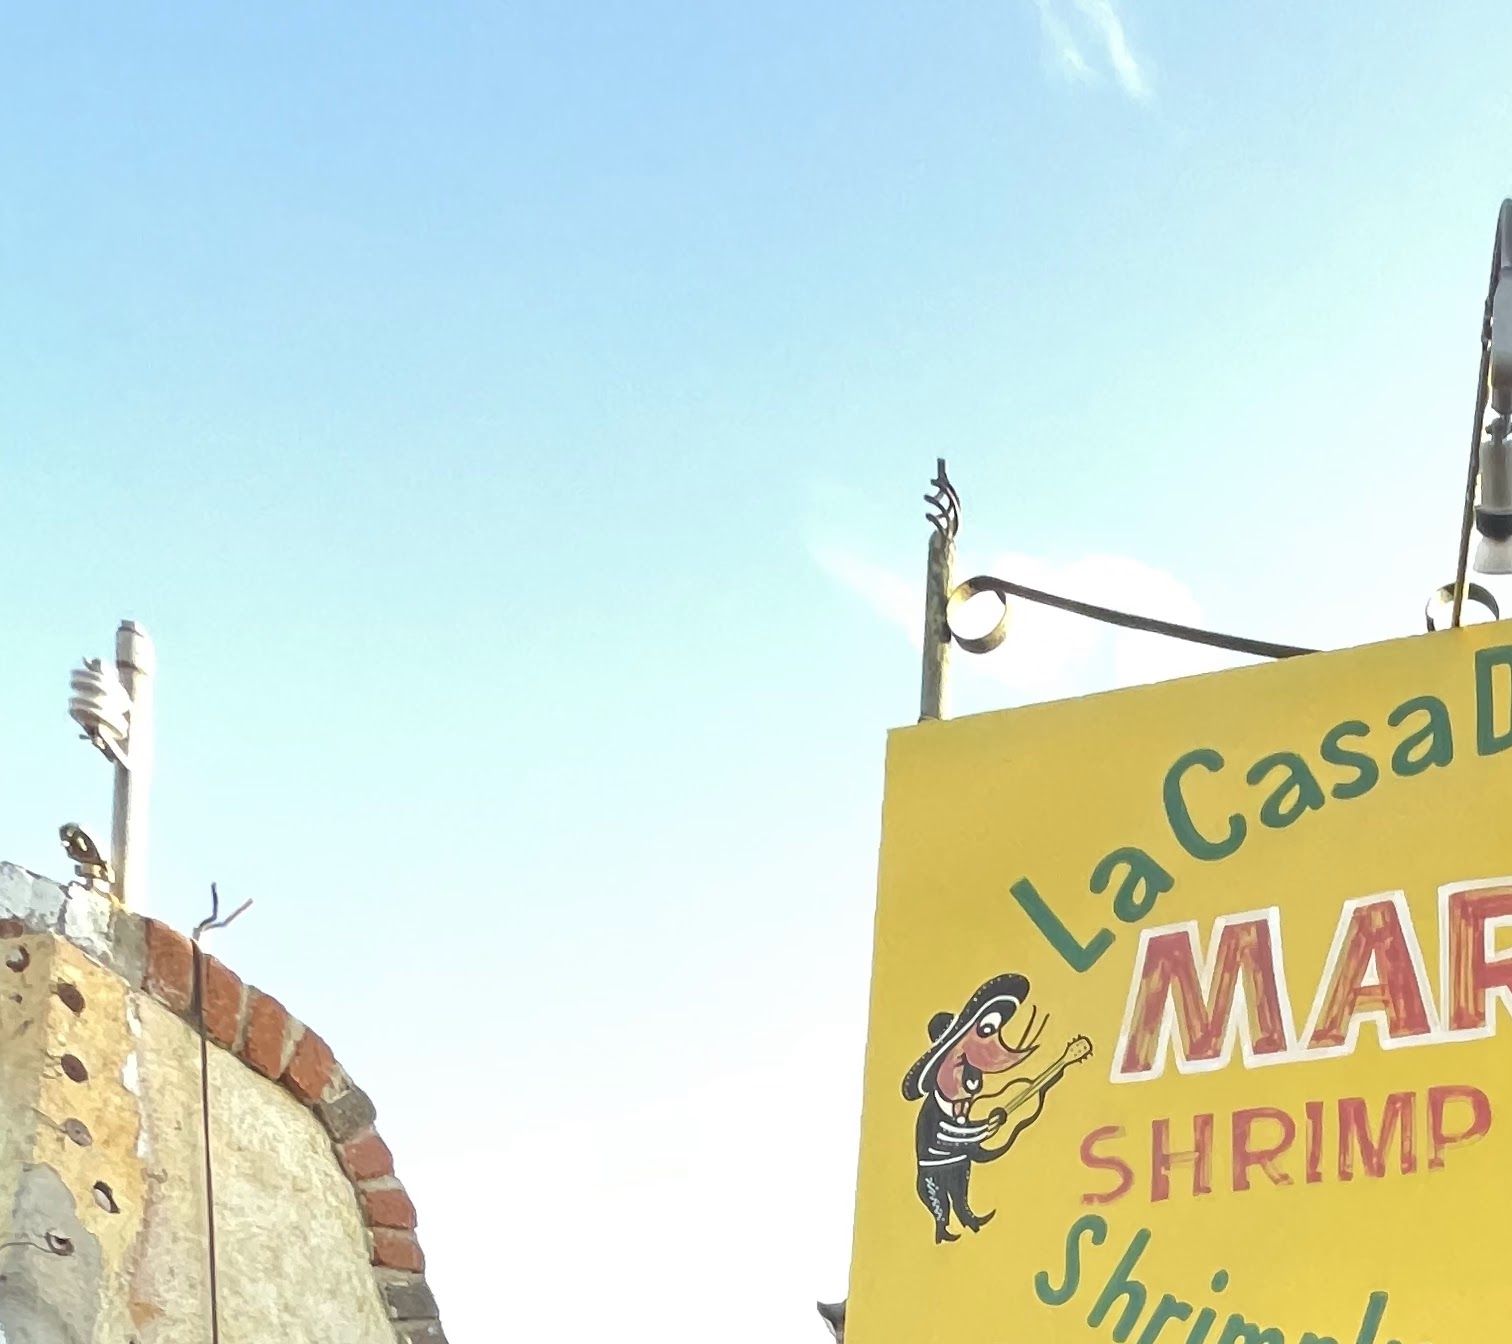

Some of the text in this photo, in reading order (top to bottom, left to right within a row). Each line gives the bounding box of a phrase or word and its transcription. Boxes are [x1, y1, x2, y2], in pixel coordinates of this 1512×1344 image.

[1009, 845, 1175, 973] La
[1160, 695, 1455, 863] Casa
[1077, 1085, 1493, 1205] SHRIMP
